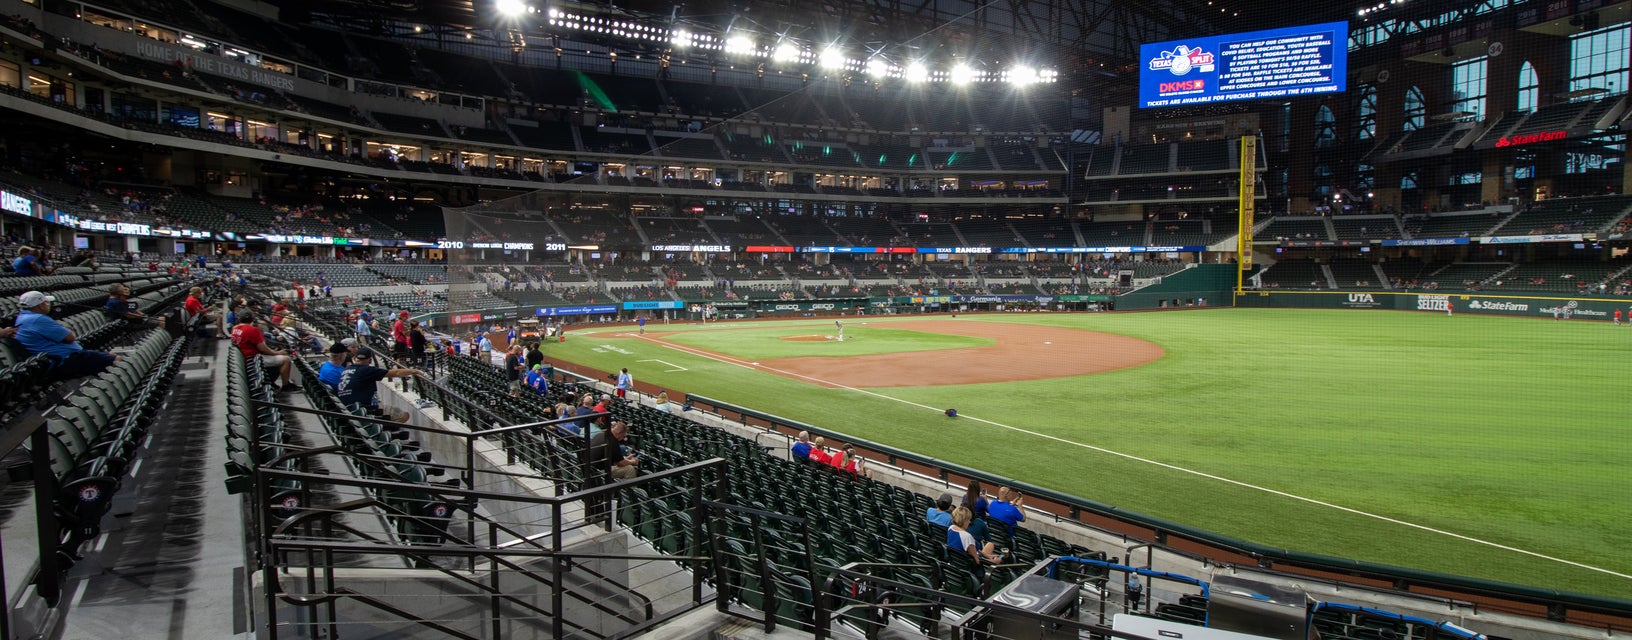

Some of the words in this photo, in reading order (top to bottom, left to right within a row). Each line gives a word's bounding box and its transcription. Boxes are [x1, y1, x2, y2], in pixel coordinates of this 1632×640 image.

[1191, 55, 1210, 64] SPLIT
[136, 41, 172, 60] HOME
[194, 56, 214, 70] THE
[216, 62, 248, 80] TEXAS
[252, 70, 294, 91] RANGERS
[1160, 81, 1193, 92] DKMS
[0, 190, 32, 216] RANGERS
[438, 241, 463, 249] 2010
[1348, 294, 1374, 302] UTA
[1417, 300, 1448, 310] SELTZER
[858, 582, 867, 594] 24
